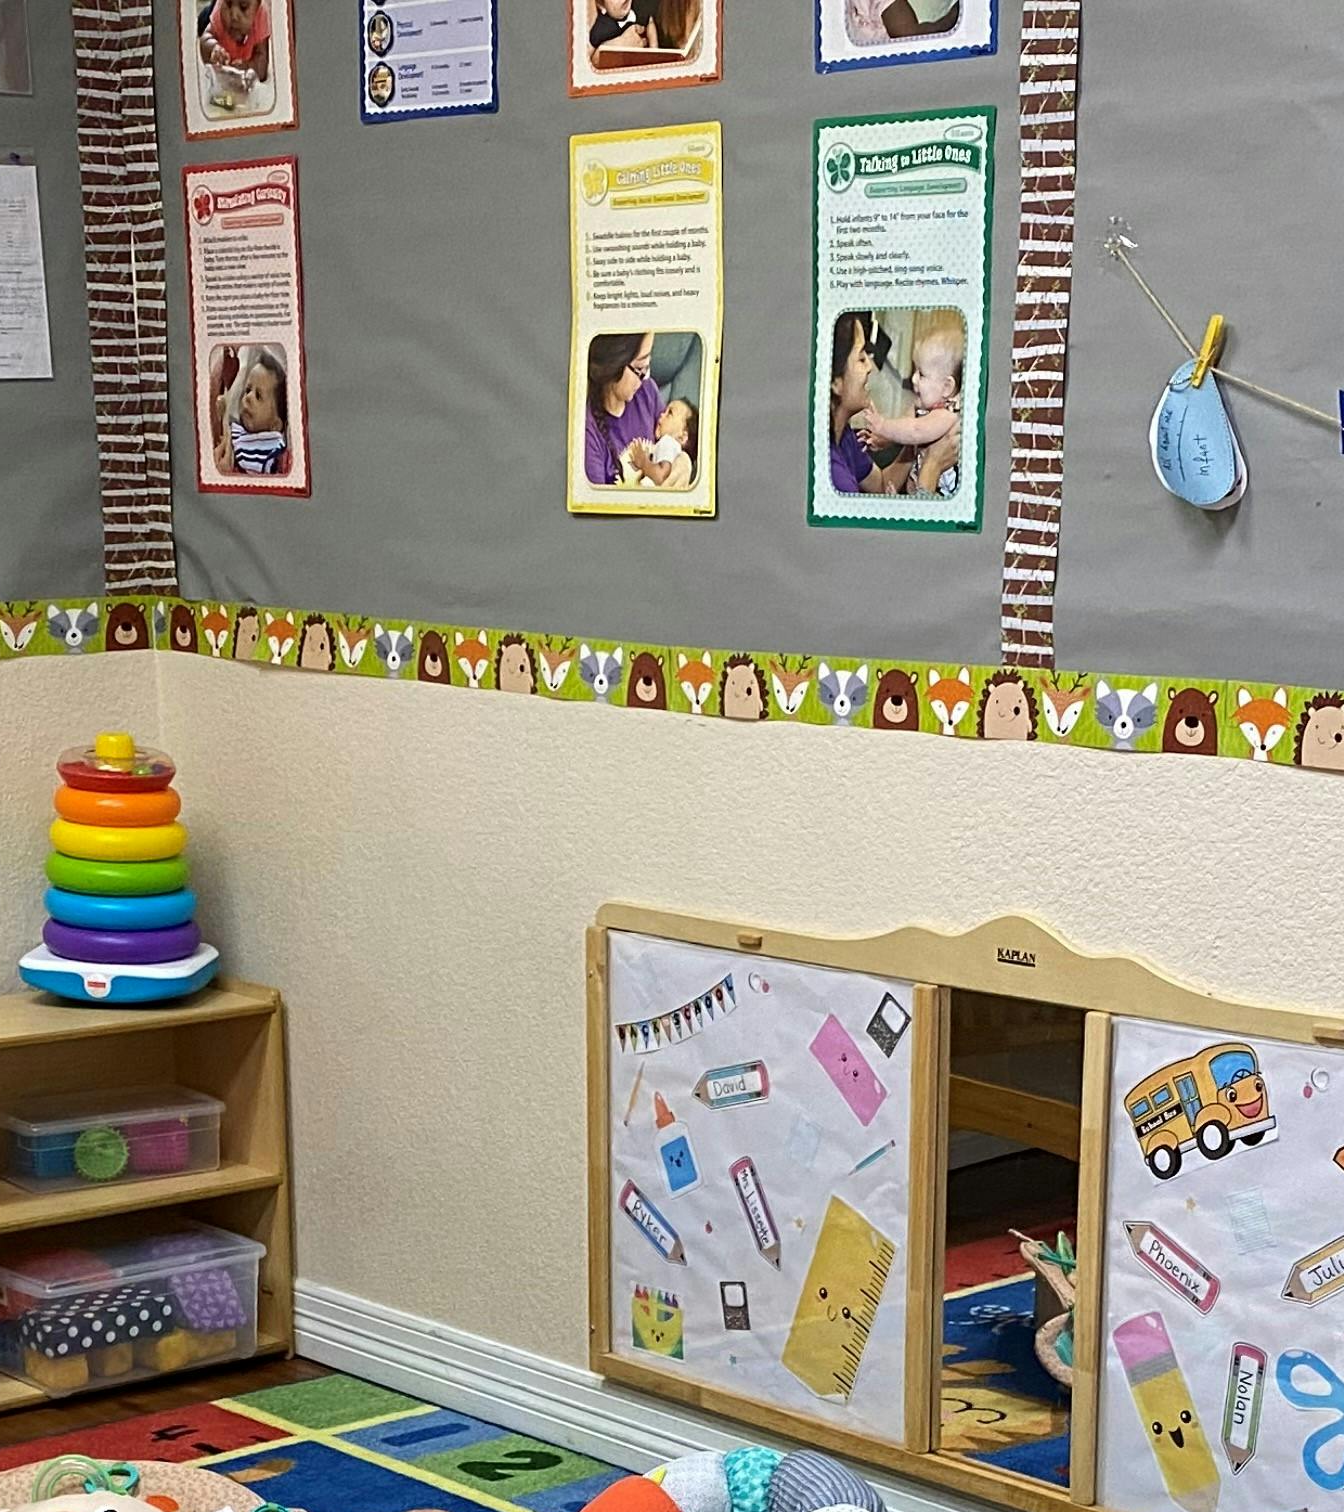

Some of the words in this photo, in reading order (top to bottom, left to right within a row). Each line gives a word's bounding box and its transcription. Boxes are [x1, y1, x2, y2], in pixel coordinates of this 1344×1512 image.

[860, 155, 898, 173] Talking
[900, 156, 910, 167] to
[911, 145, 943, 164] Little
[944, 145, 972, 163] Ones
[997, 947, 1036, 963] KAPLAN
[712, 1075, 746, 1097] David
[1140, 1115, 1164, 1134] School
[1163, 1109, 1177, 1121] Bus
[631, 1199, 667, 1243] Ryker
[1148, 1239, 1200, 1293] Phoenix
[1233, 1369, 1254, 1425] Nolan
[457, 1450, 563, 1481] 2
